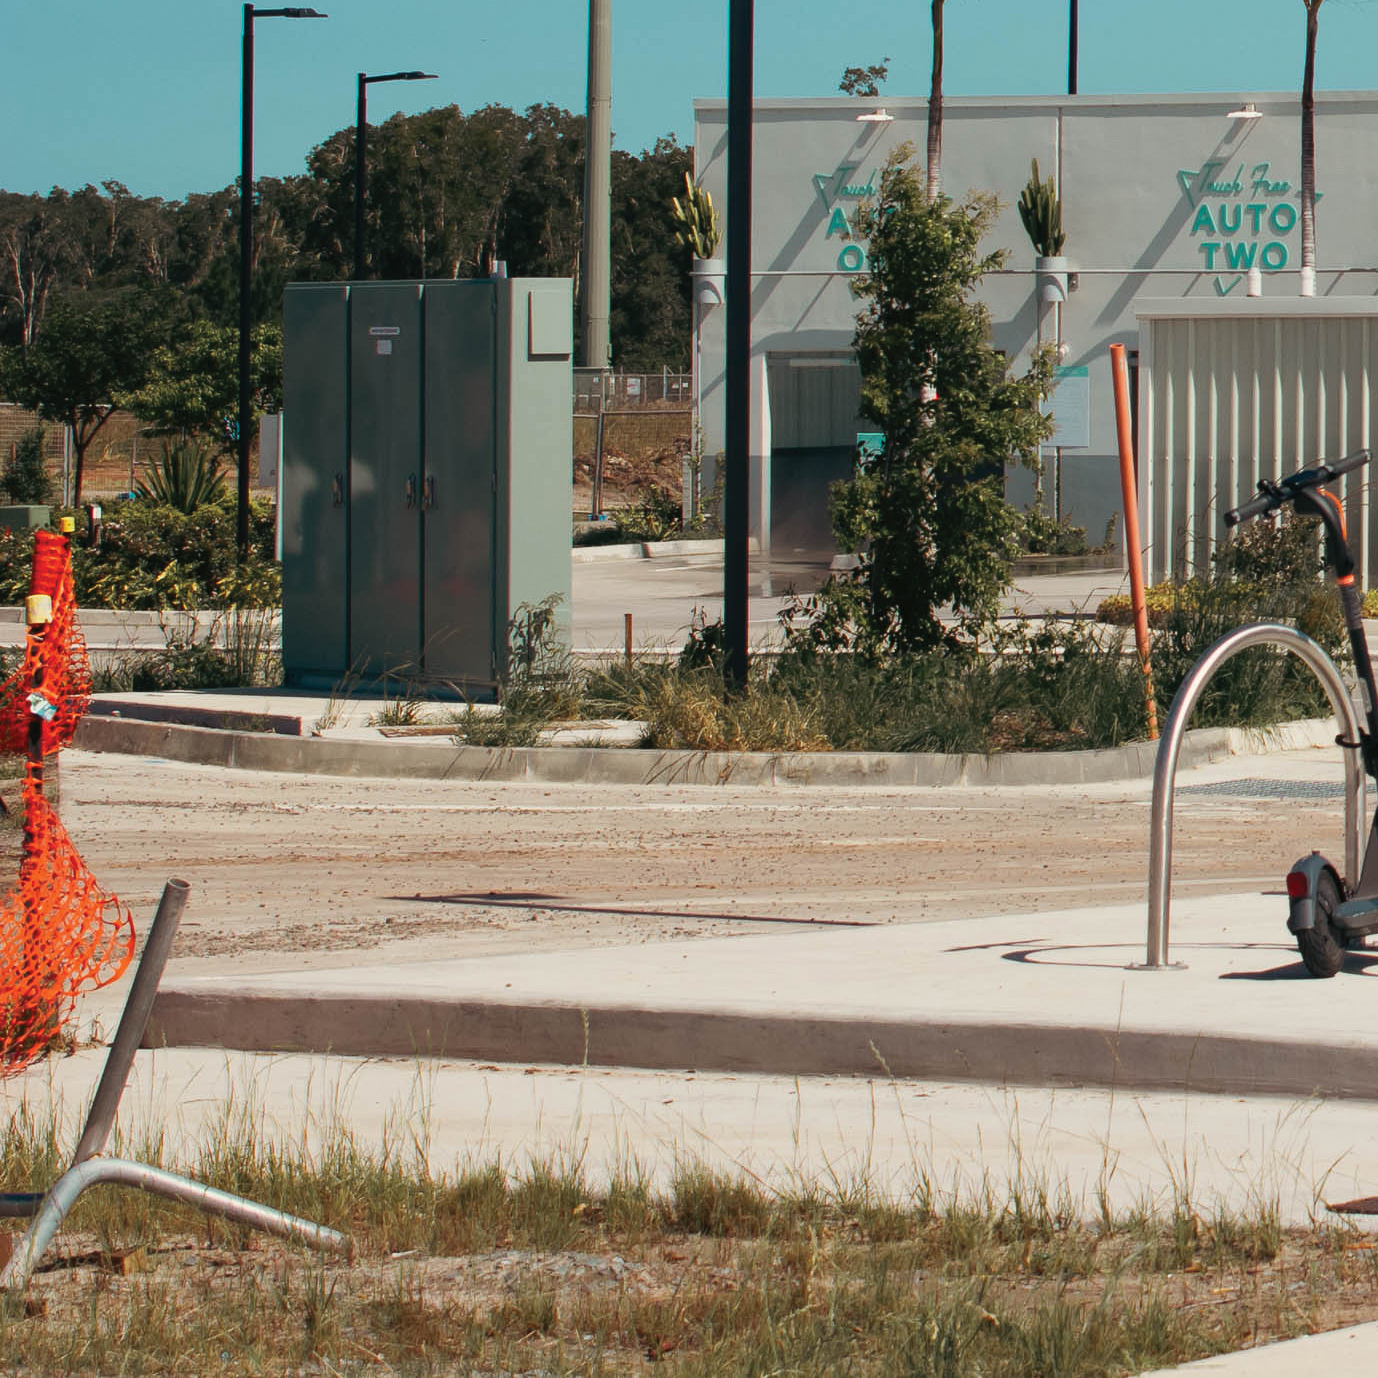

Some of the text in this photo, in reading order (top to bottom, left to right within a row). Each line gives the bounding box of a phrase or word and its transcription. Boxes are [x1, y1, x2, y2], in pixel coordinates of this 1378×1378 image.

[1199, 162, 1292, 201] Touch Free
[1193, 203, 1297, 232] AUTO
[1201, 241, 1288, 271] TWO
